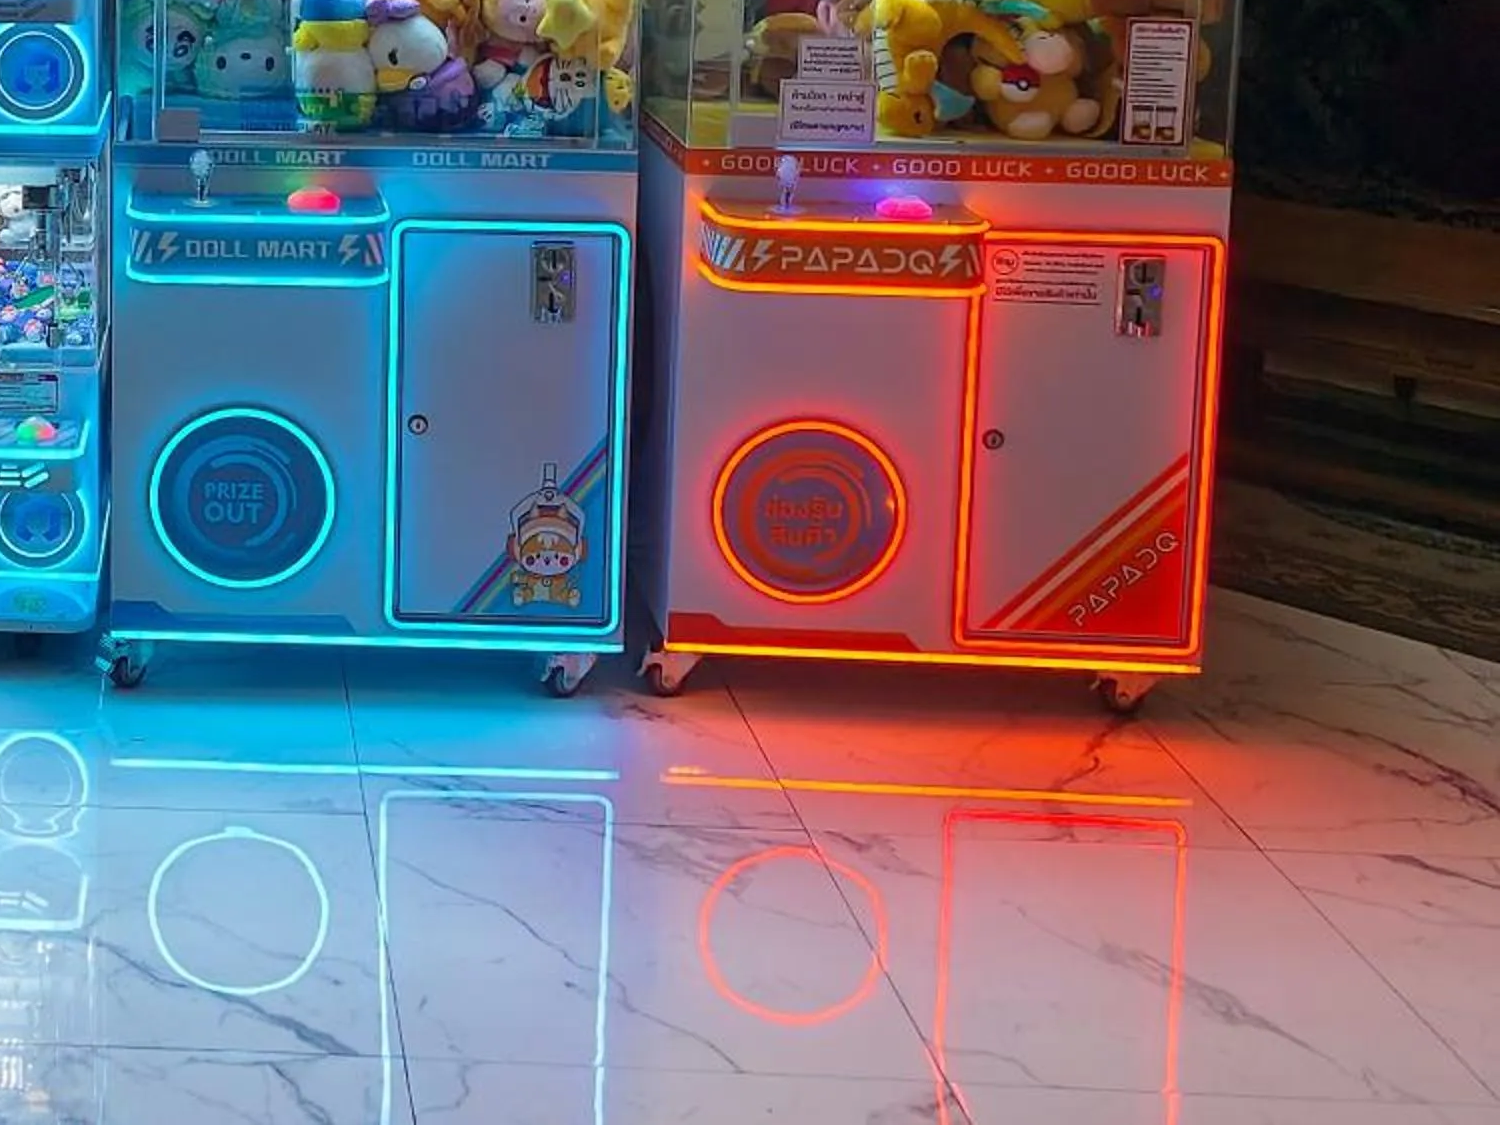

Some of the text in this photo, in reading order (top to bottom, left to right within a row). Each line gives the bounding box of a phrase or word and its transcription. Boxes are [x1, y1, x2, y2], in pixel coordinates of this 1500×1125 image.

[275, 151, 346, 165] MART
[412, 152, 553, 168] DOLL MART
[721, 154, 780, 170] GOO
[892, 159, 1032, 178] GOOD LUCK
[1066, 161, 1209, 181] GOOD LUCK
[185, 240, 332, 259] DOLL MART
[781, 249, 936, 273] PAPADQ
[205, 483, 263, 500] PRIZE
[204, 503, 263, 523] OUT
[1068, 531, 1180, 627] PAPADQ
